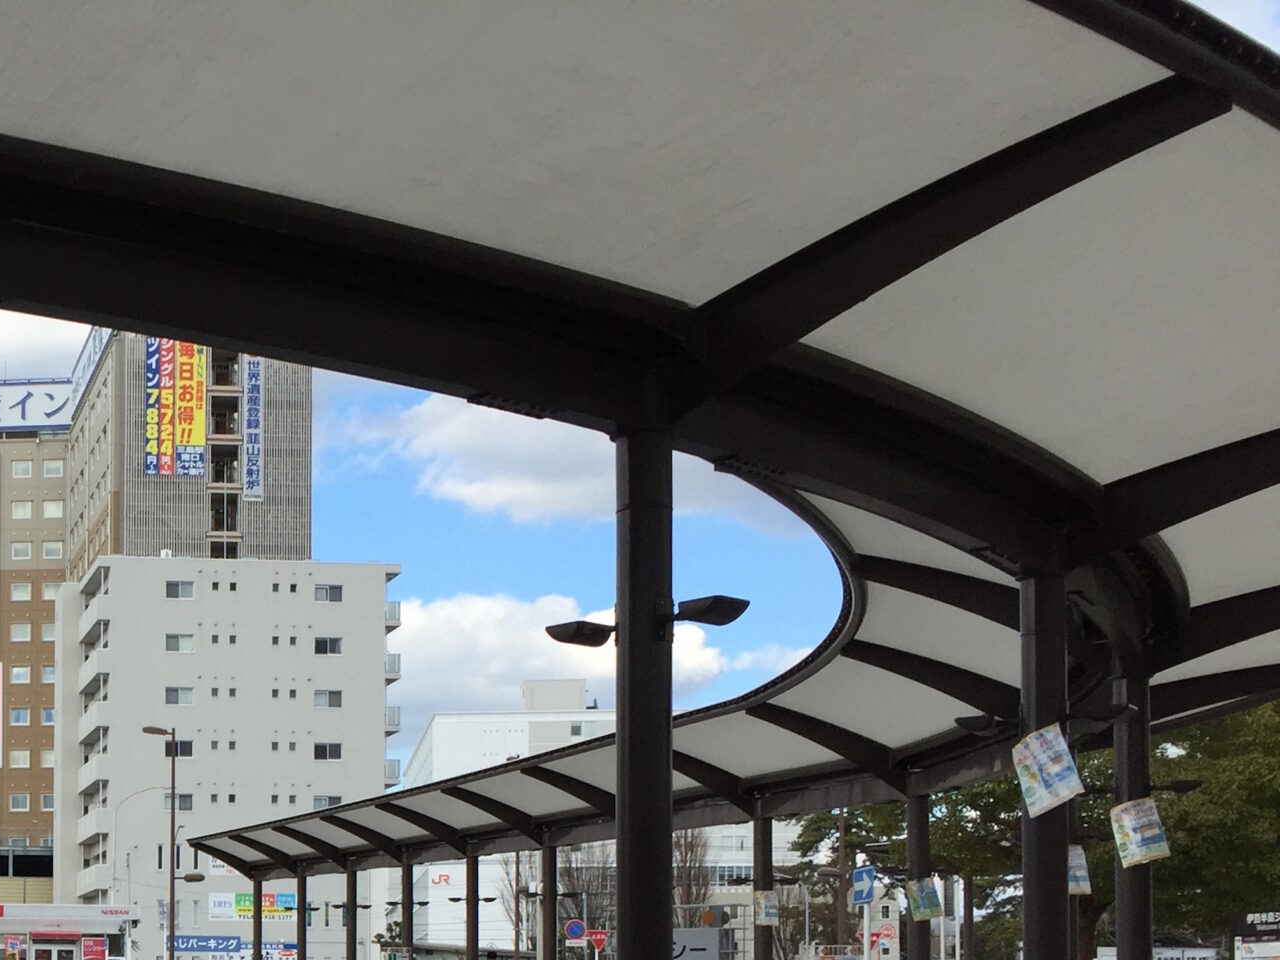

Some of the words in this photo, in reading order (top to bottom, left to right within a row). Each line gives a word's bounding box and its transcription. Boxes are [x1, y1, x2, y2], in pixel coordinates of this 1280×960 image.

[246, 360, 261, 430] 世界遺産登録
[431, 874, 450, 885] JR
